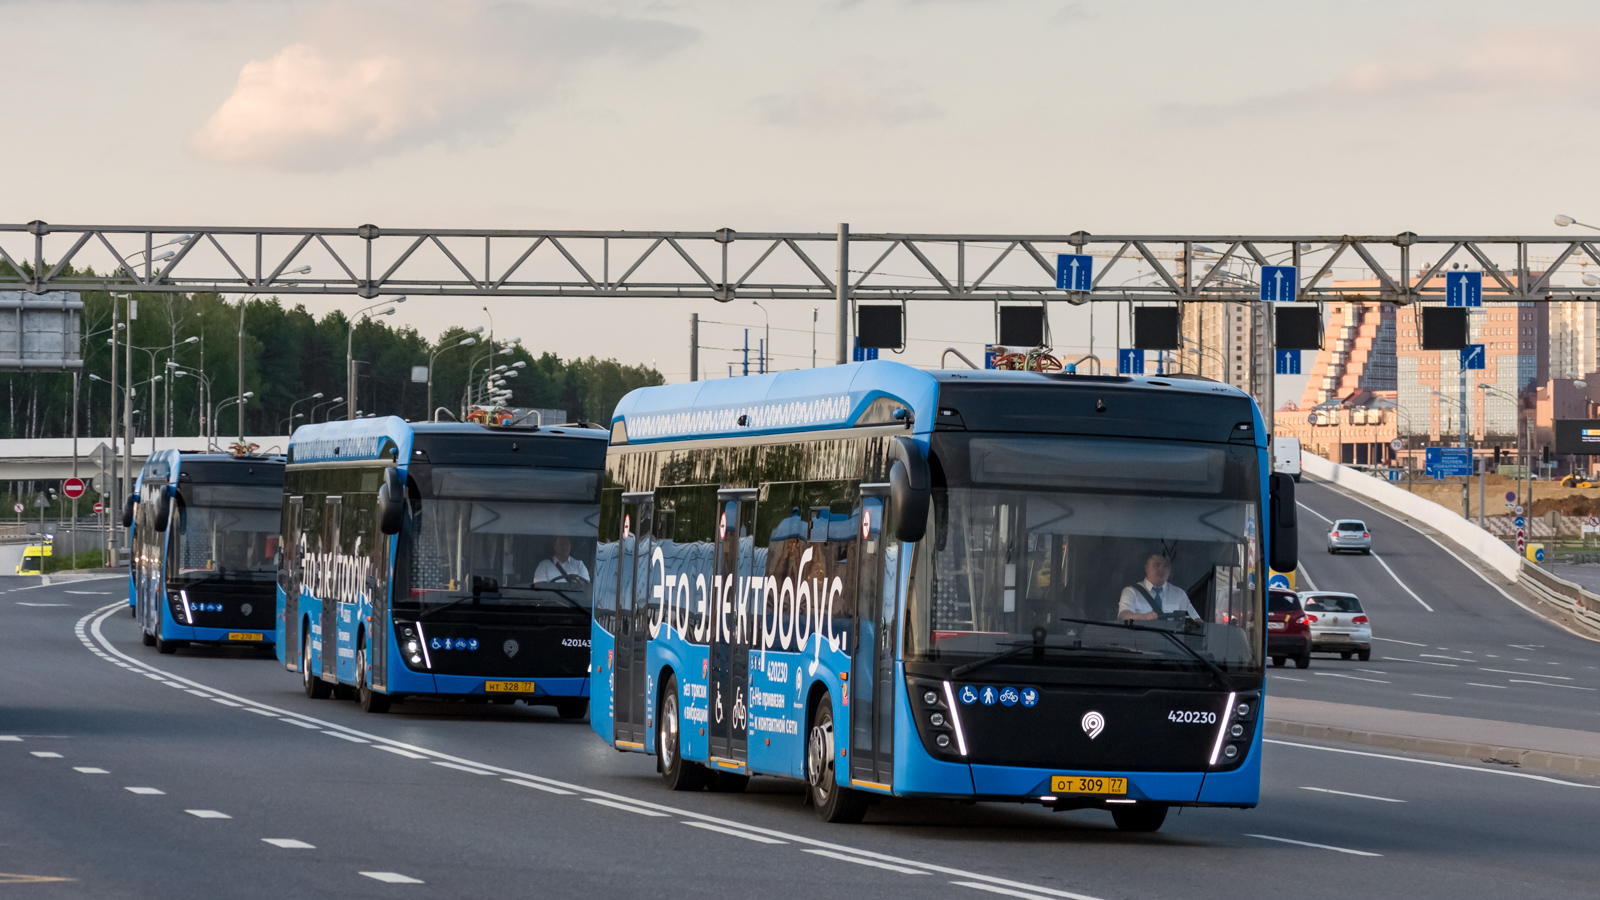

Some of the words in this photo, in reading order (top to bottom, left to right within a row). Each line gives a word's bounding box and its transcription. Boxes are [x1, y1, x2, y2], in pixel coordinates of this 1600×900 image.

[648, 545, 690, 640] Это
[693, 545, 847, 678] электробус.
[561, 638, 591, 648] 420143
[767, 661, 788, 683] 420230
[503, 682, 519, 691] 328
[523, 682, 532, 690] 77
[762, 691, 785, 711] привязан
[758, 715, 785, 734] контактной
[785, 719, 798, 735] сети
[1167, 710, 1217, 724] 420230
[1057, 780, 1073, 791] ОТ
[1079, 778, 1103, 792] 309
[1110, 779, 1123, 789] 77
